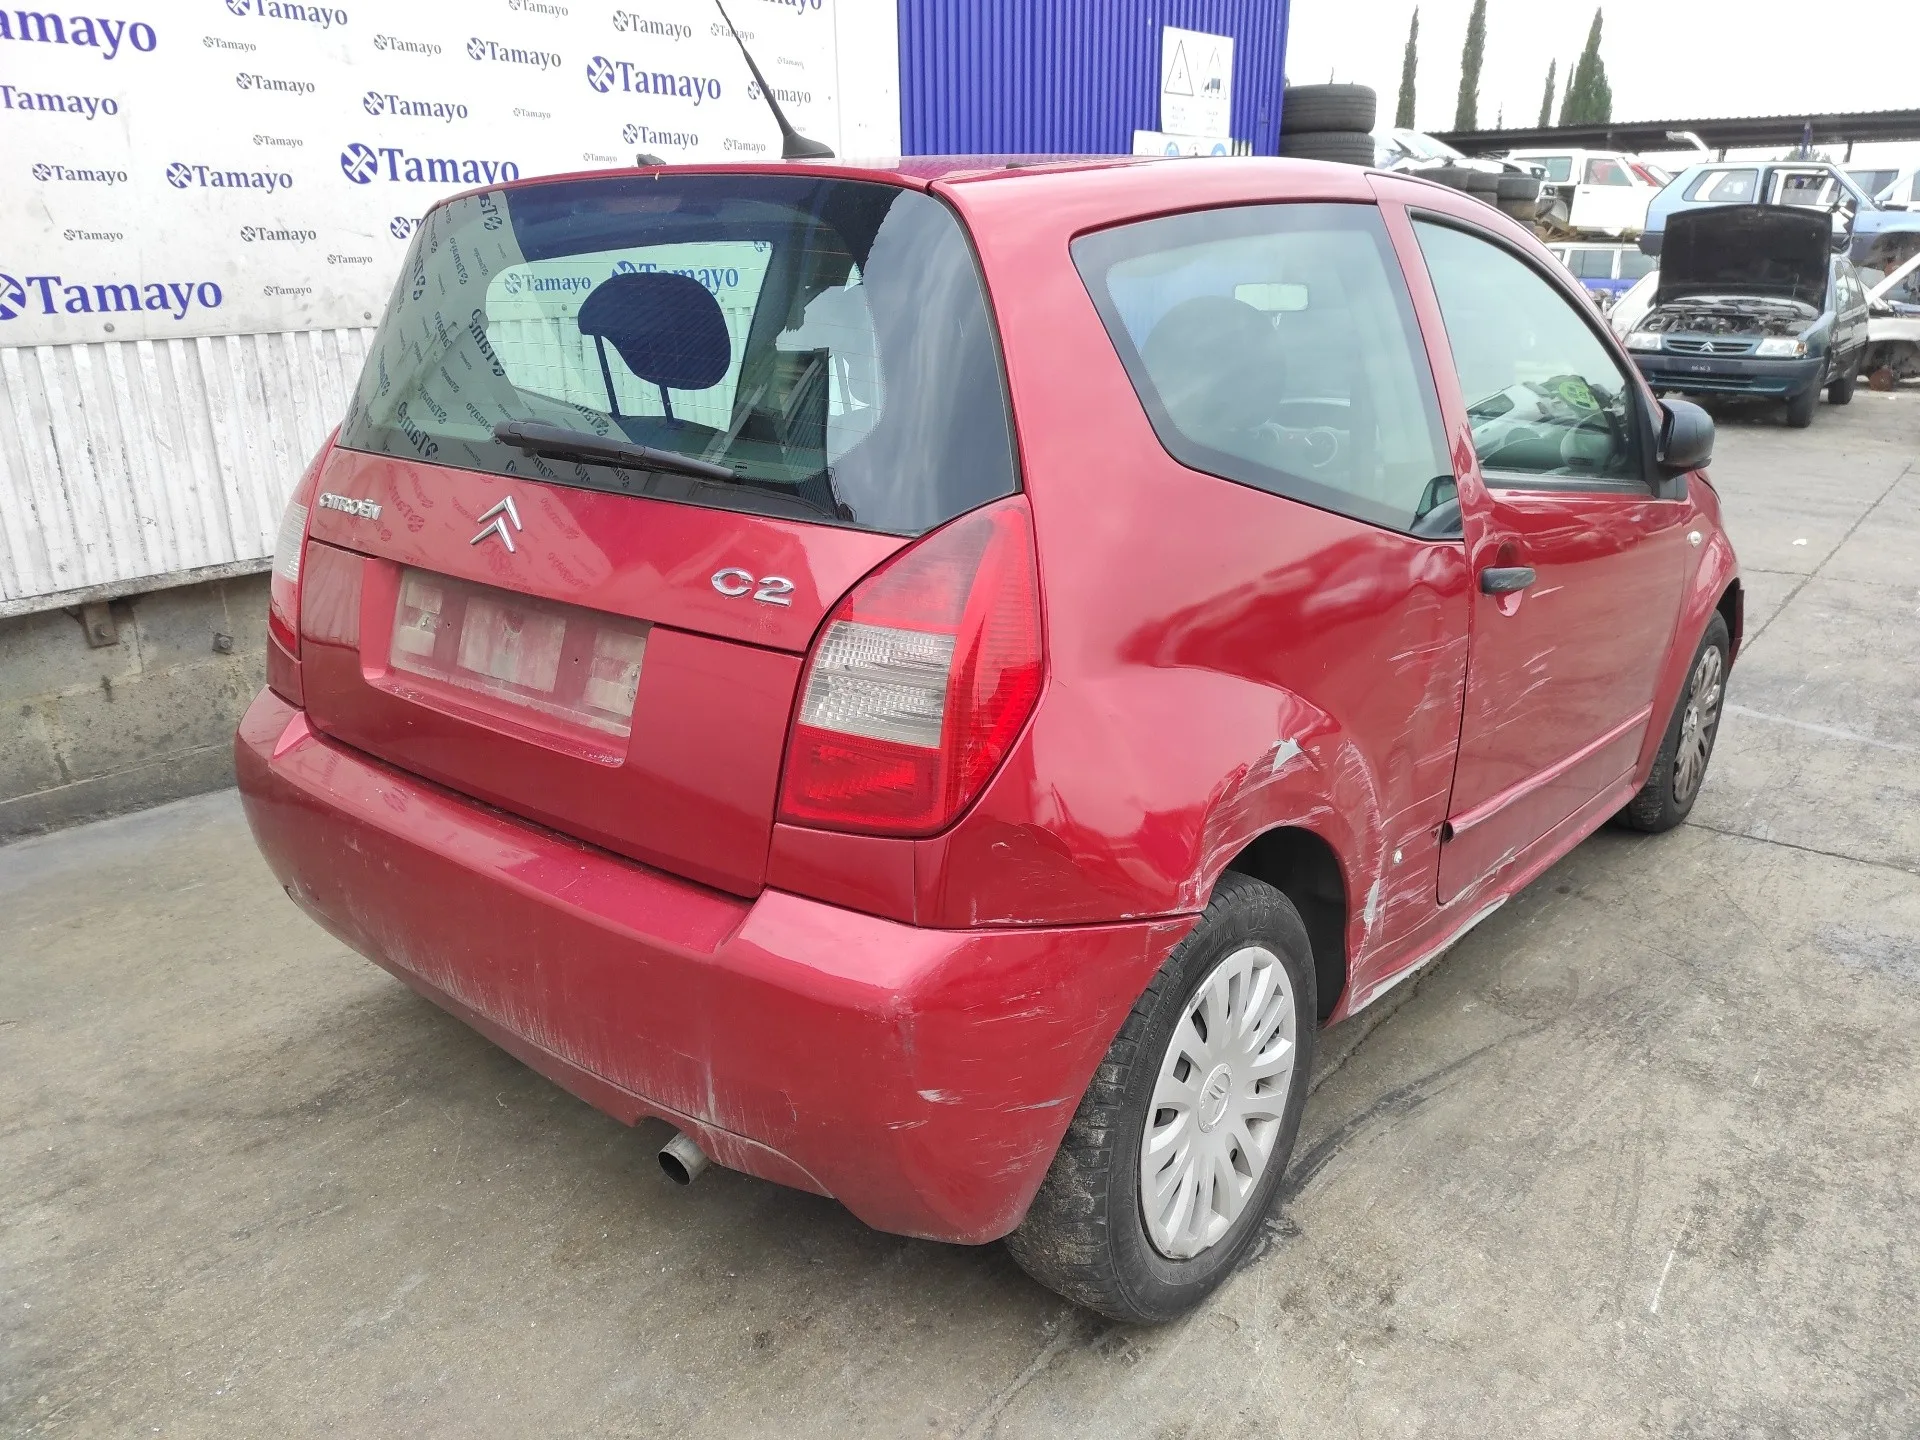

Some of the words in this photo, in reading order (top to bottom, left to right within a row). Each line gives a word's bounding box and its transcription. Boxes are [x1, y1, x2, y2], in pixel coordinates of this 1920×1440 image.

[257, 0, 347, 29] Tamayo
[521, 0, 569, 18] Tamayo
[0, 10, 157, 60] amayo
[629, 14, 691, 41] Tamayo
[213, 37, 257, 52] Tamayo
[388, 37, 442, 57] Tamayo
[486, 41, 561, 68] Tamayo
[252, 75, 315, 96] Tamayo
[616, 61, 721, 106] Tamayo
[0, 85, 118, 121] Tamayo
[764, 85, 811, 107] amayo
[384, 95, 468, 123] Tamayo
[521, 108, 551, 120] Tamayo
[263, 136, 303, 148] Tamayo
[639, 126, 698, 150] Tamayo
[733, 140, 766, 153] Tamayo
[379, 148, 520, 184] Tamayo
[591, 153, 618, 164] Tamayo
[51, 165, 128, 186] Tamayo
[192, 165, 293, 194] Tamayo
[75, 230, 123, 242] Tamayo
[256, 227, 317, 245] Tamayo
[336, 254, 373, 266] Tamayo
[273, 285, 312, 297] Tamayo
[522, 274, 591, 295] Tamayo
[25, 275, 222, 320] Tamayo
[319, 492, 382, 520] CITROËN
[711, 567, 795, 607] C2
